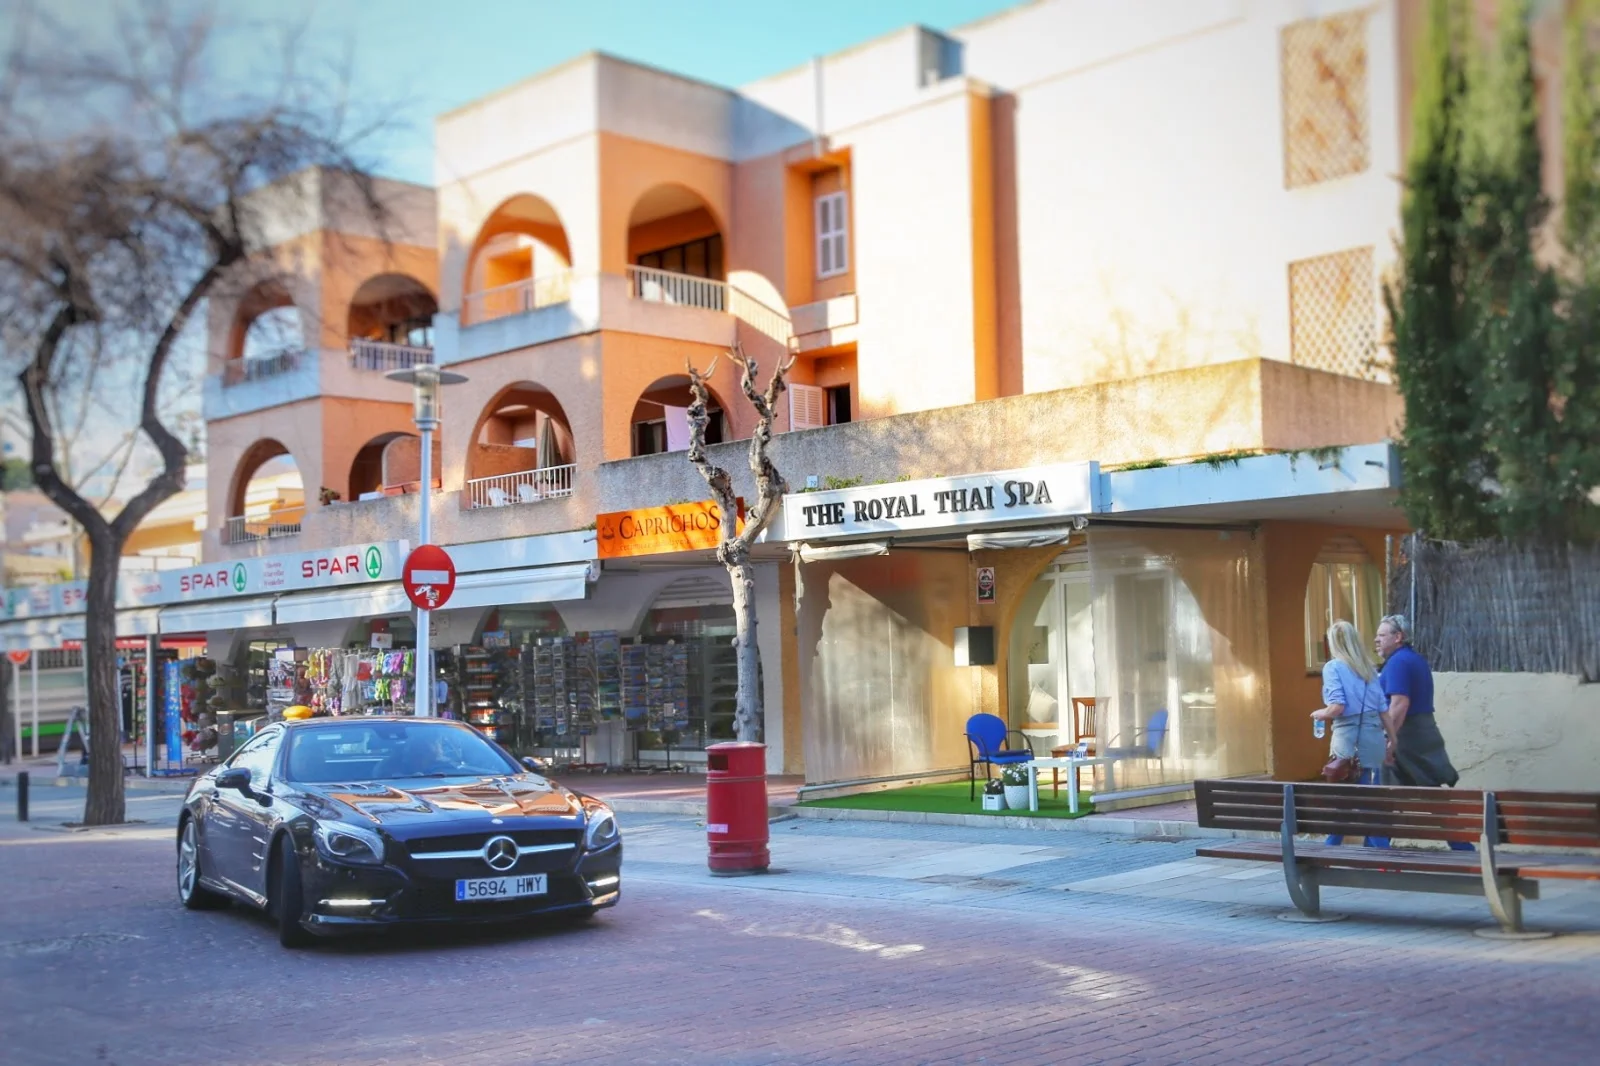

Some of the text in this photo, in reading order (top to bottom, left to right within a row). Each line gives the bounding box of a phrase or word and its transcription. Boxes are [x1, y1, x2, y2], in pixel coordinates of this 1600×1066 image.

[802, 480, 1053, 527] THE ROYAL THAI SPA
[618, 505, 720, 540] CAPRICHOS
[301, 555, 360, 579] SPAR
[179, 570, 229, 593] SPAR
[467, 880, 507, 897] 5694
[516, 876, 542, 894] HWY
